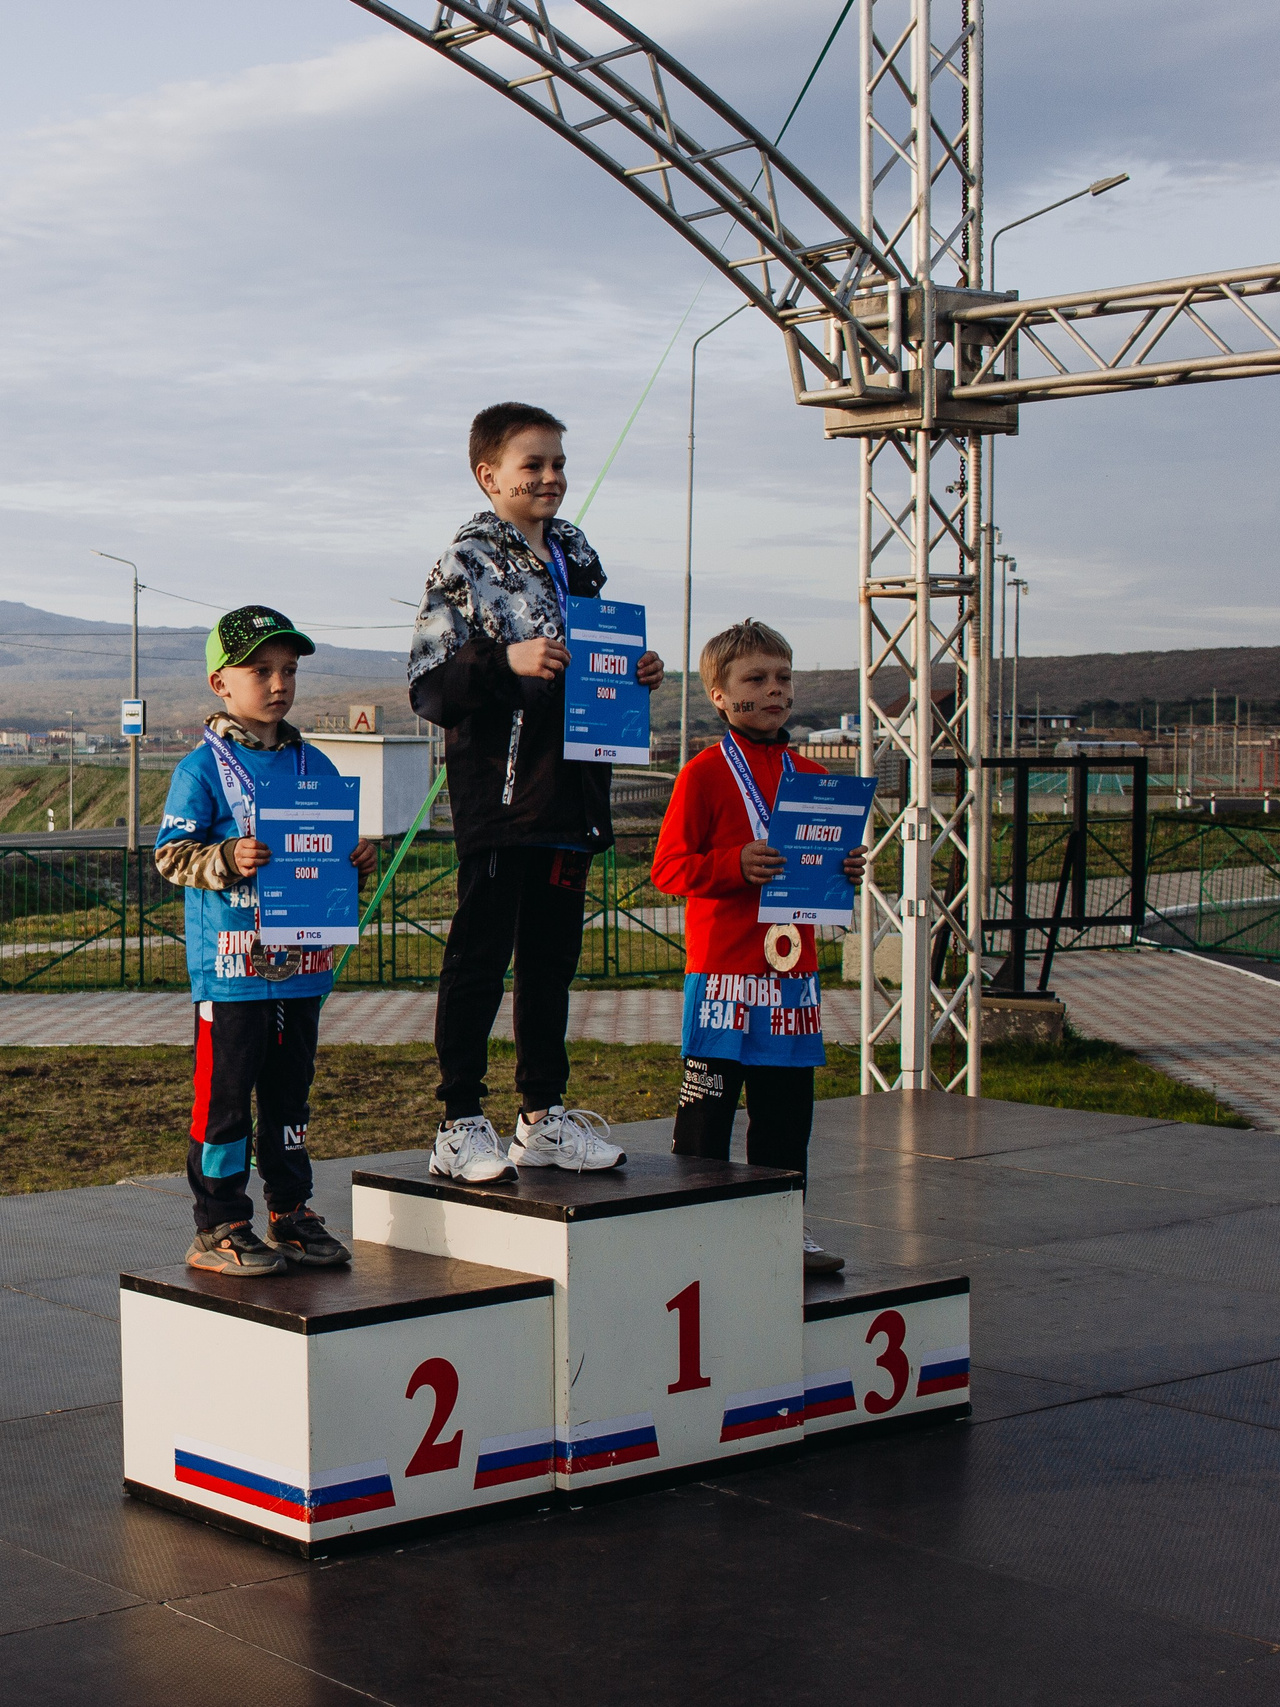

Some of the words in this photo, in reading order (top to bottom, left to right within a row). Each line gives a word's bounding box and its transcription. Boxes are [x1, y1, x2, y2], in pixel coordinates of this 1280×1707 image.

[354, 711, 371, 731] А
[603, 750, 617, 758] ПСБ
[729, 745, 746, 774] ОБЛАСТЬ
[223, 768, 235, 788] ПСБ
[743, 773, 770, 822] САХАЛИНСКАЯ
[162, 814, 197, 833] ПСБ
[806, 824, 843, 842] МЕСТО
[294, 833, 333, 853] МЕСТО
[801, 854, 815, 865] 500
[295, 866, 310, 879] 500
[306, 931, 322, 939] ПСБ
[666, 1280, 711, 1396] 1
[864, 1309, 908, 1416] 3
[404, 1357, 464, 1479] 2
